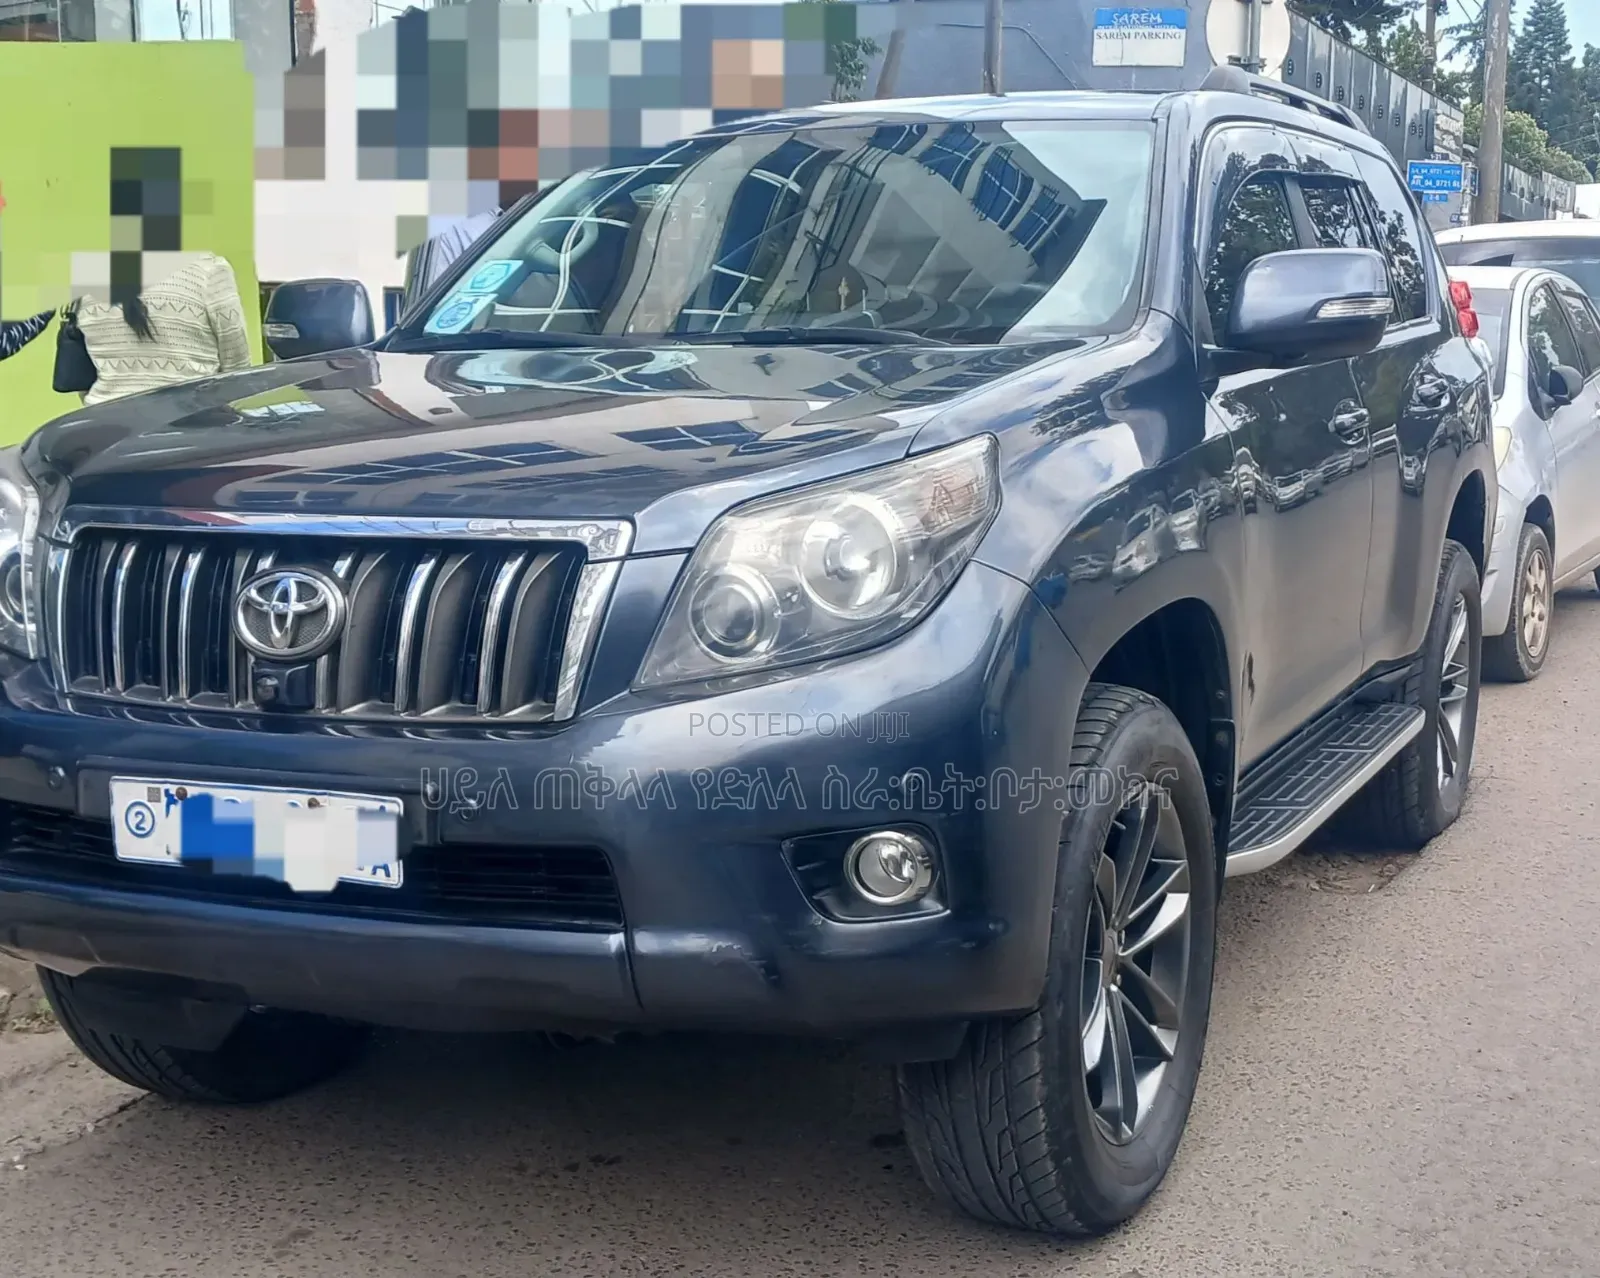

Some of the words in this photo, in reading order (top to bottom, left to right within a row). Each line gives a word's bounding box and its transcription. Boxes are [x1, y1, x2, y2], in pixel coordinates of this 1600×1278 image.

[1111, 13, 1163, 25] SAREM
[1096, 31, 1131, 40] SAREM
[1134, 31, 1182, 40] PARKING
